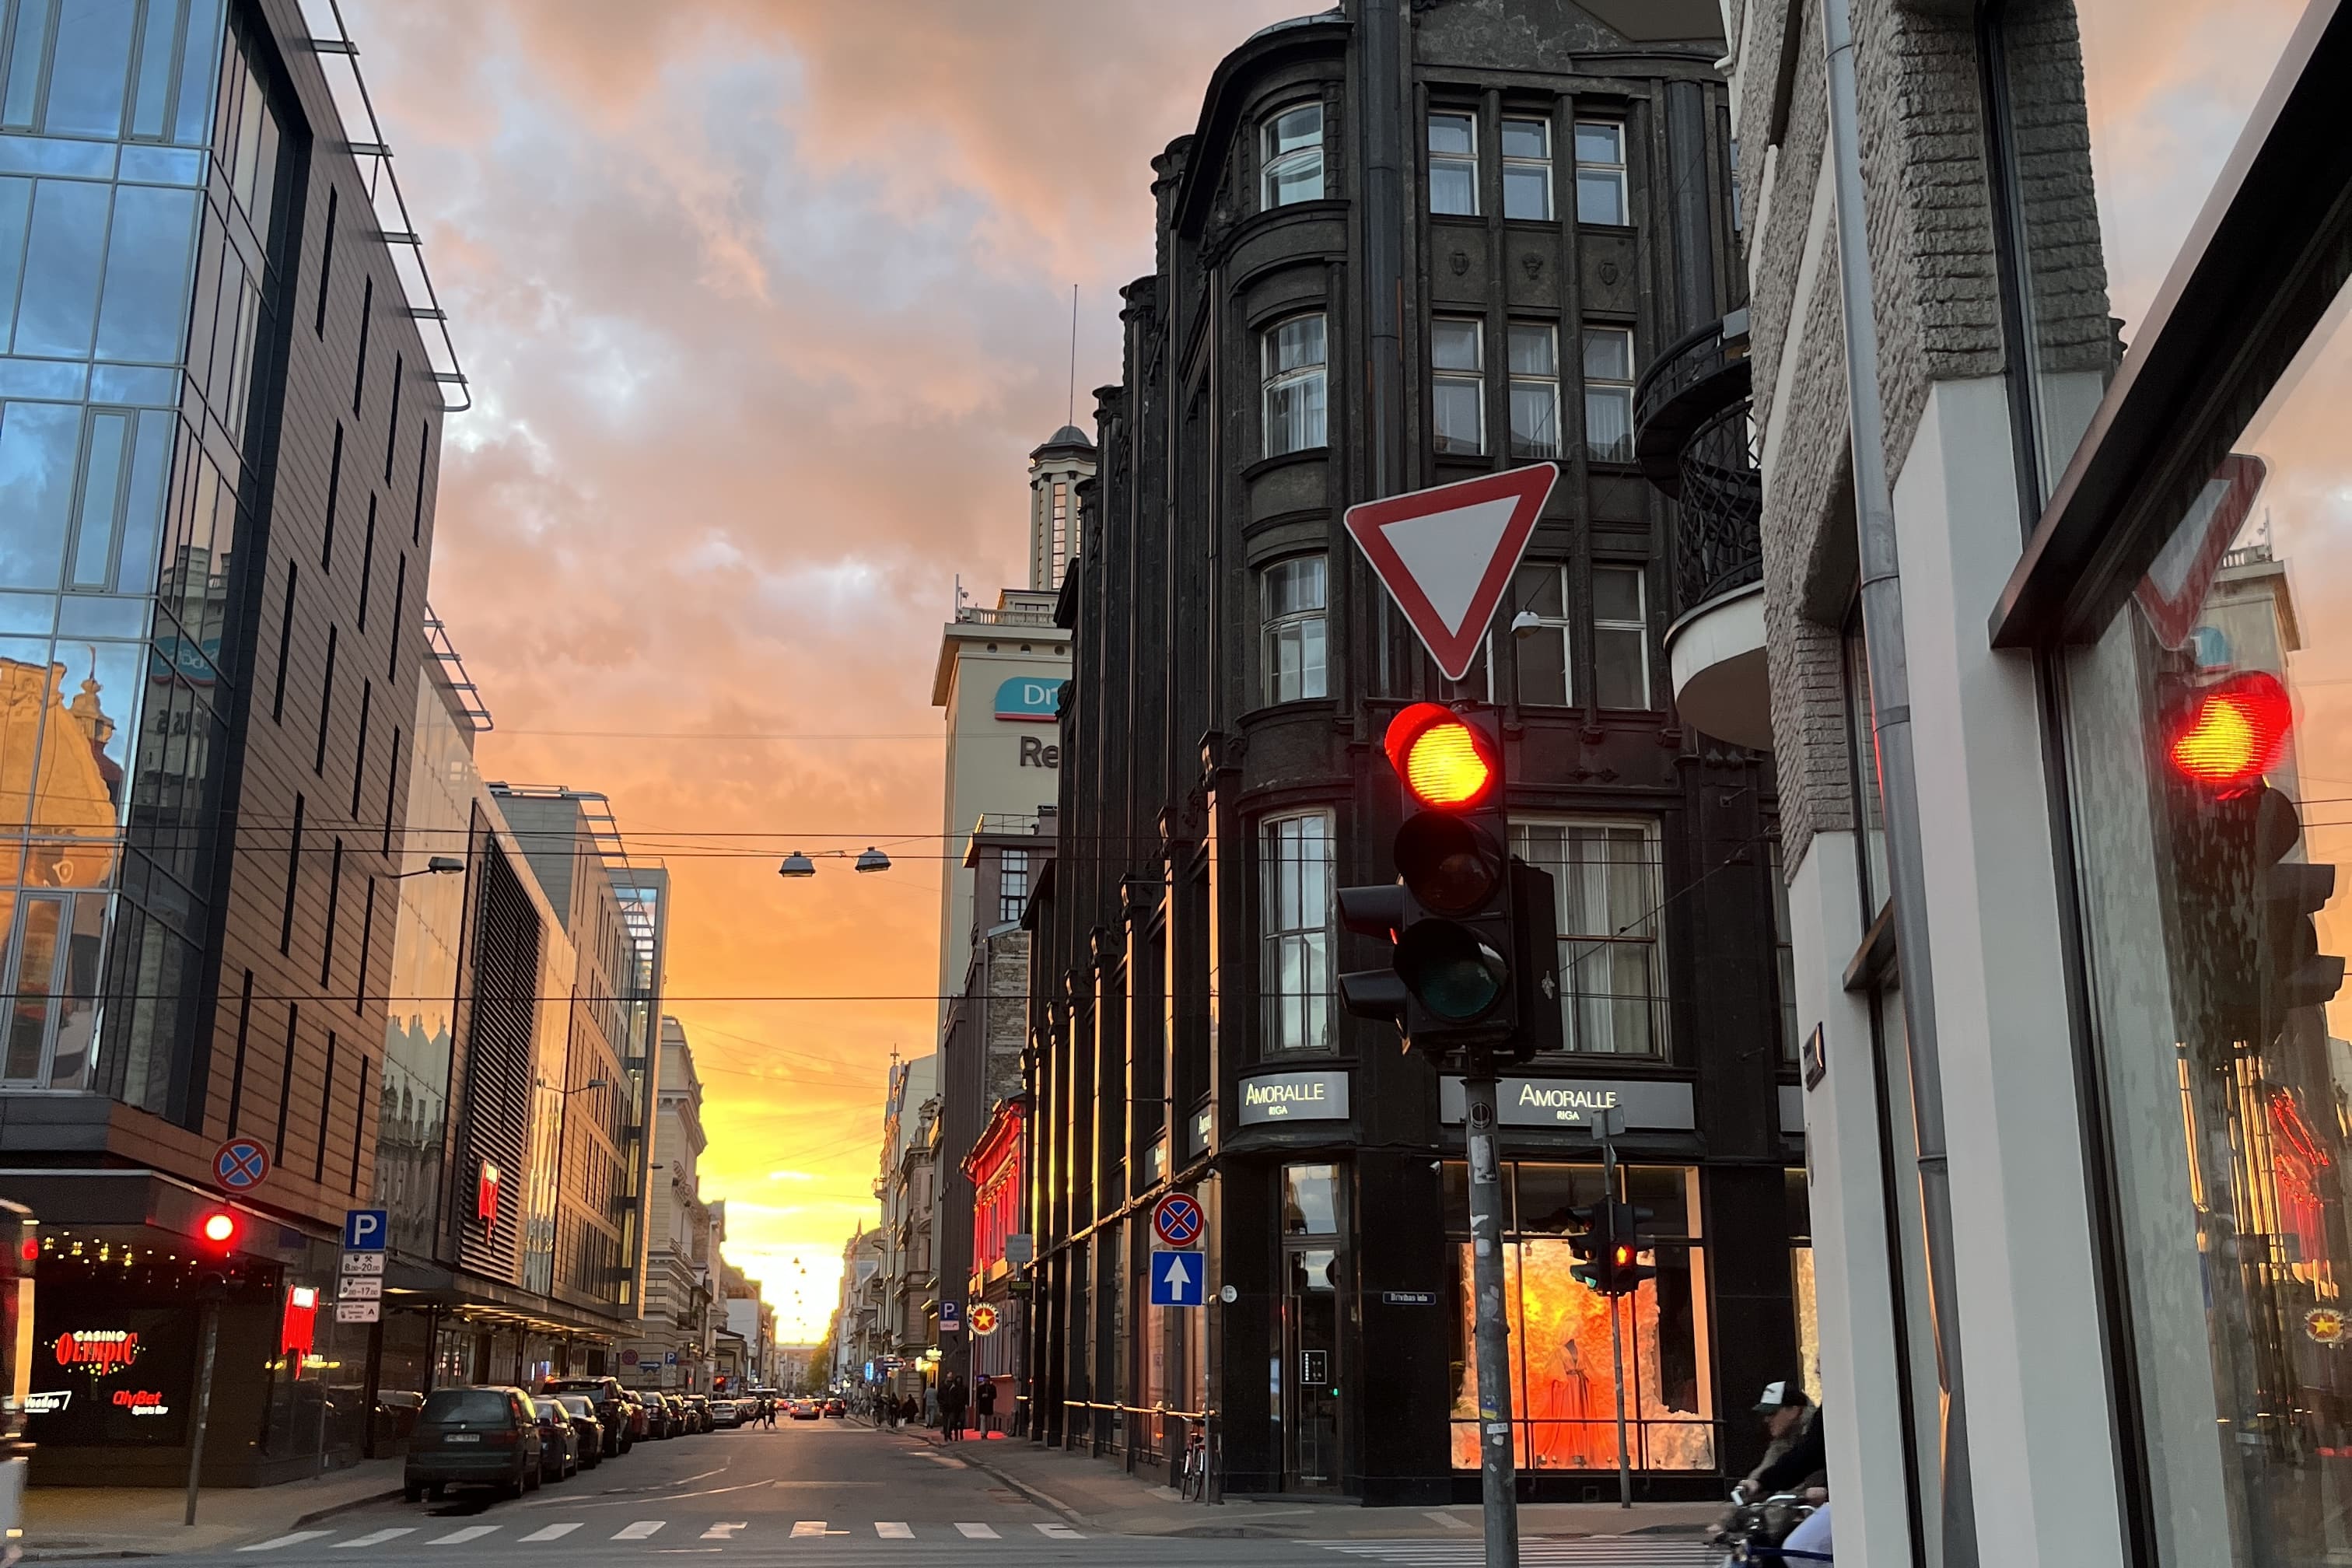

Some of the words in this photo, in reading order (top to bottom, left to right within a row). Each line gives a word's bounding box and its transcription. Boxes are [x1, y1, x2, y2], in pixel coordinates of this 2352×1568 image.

[1020, 735, 1059, 768] Re
[1246, 1083, 1325, 1105] AMORALLE
[1519, 1084, 1617, 1108] AMORALLE
[1269, 1106, 1288, 1115] RIGA
[1556, 1110, 1580, 1121] RIGA
[354, 1214, 377, 1245] P
[945, 1303, 954, 1318] P
[73, 1331, 128, 1342] CASINO
[667, 1353, 675, 1363] P
[113, 1391, 162, 1408] OlyBet
